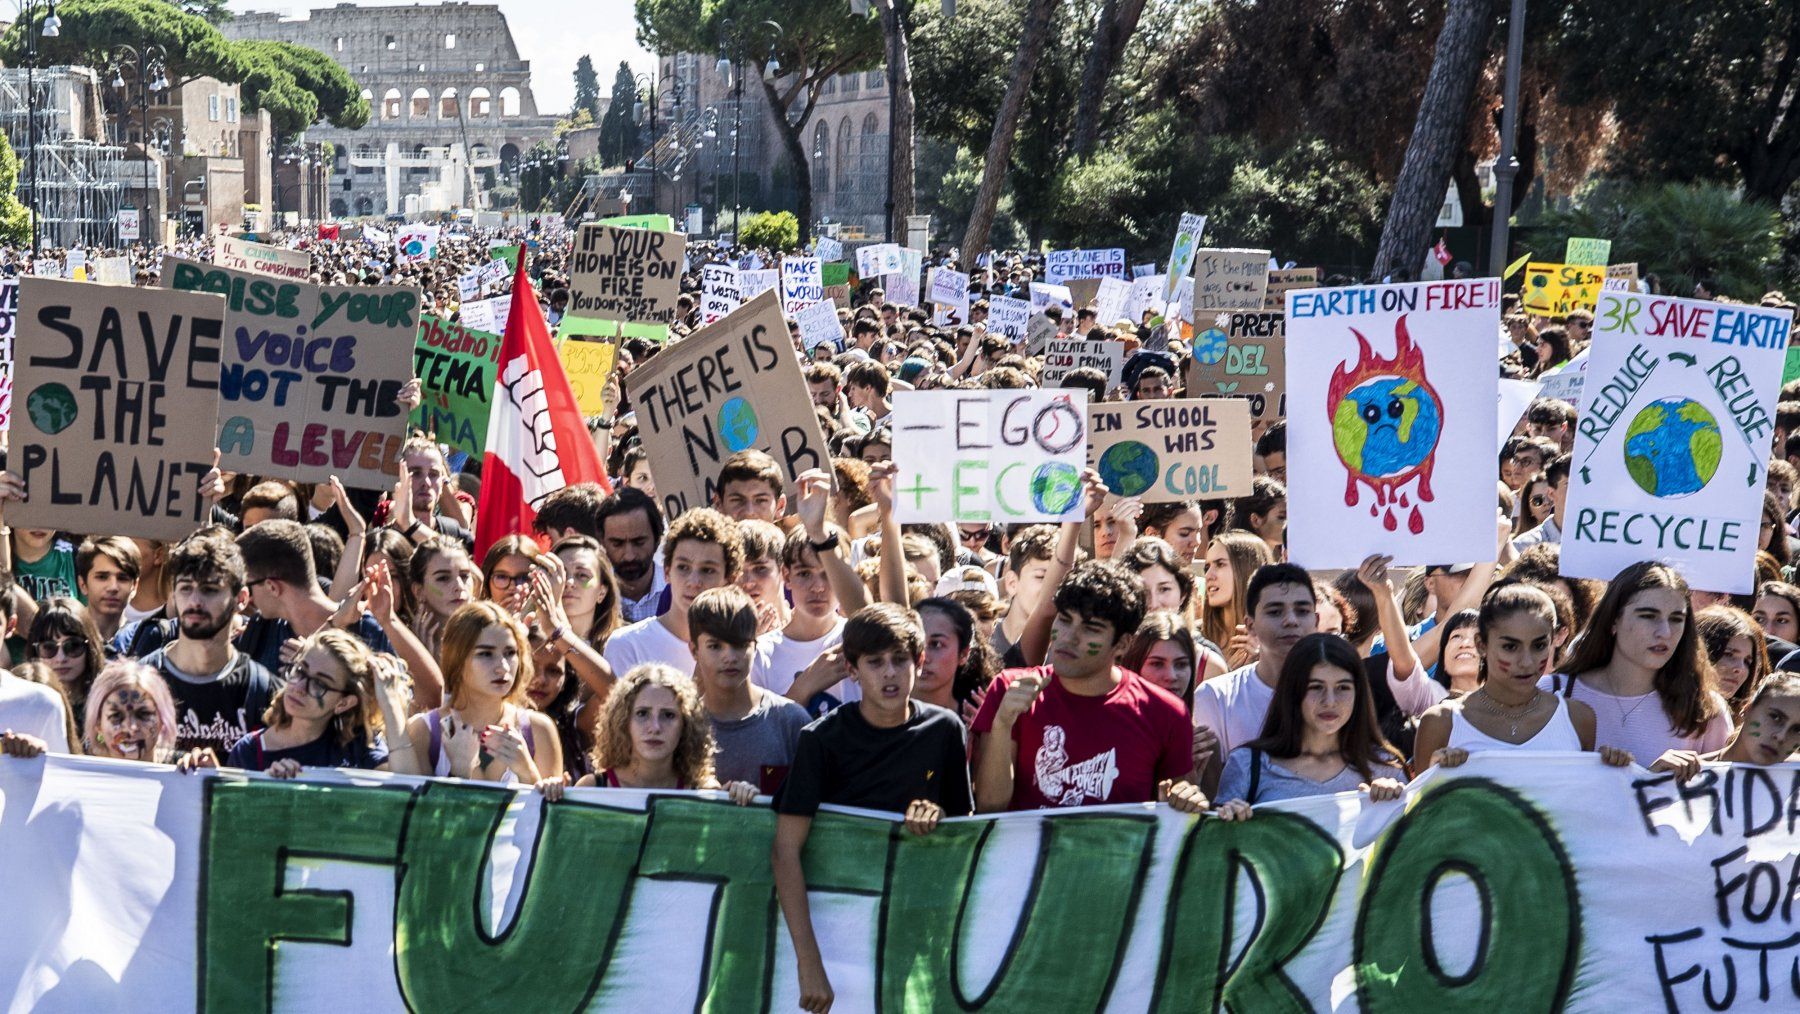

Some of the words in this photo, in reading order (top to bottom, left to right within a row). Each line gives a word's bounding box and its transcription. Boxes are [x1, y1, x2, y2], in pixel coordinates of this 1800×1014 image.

[224, 242, 235, 255] IL
[609, 227, 664, 261] YOUR
[1049, 252, 1069, 263] THIS
[1072, 251, 1106, 263] PLANET
[1110, 250, 1122, 261] IS
[574, 252, 626, 277] HOME
[647, 261, 677, 280] ON
[784, 261, 818, 275] MAKE
[172, 262, 300, 319] RAISE
[623, 297, 658, 312] JUST
[708, 301, 729, 313] ORA
[786, 286, 824, 299] WORLD
[1292, 289, 1376, 319] EARTH
[1380, 287, 1419, 312] ON
[1425, 281, 1500, 312] FIRE!!
[1003, 323, 1019, 340] YOU
[1600, 297, 1642, 335] 3R
[1644, 300, 1715, 338] SAVE
[1711, 308, 1791, 350] EARTH
[30, 305, 223, 390] SAVE
[1046, 354, 1074, 367] CULO
[1079, 355, 1112, 368] PRIMA
[1048, 341, 1087, 353] ALZATE
[1094, 343, 1105, 354] IL
[1225, 344, 1269, 376] DEL
[219, 362, 302, 407] NOT
[414, 347, 486, 403] TEMA
[639, 344, 743, 434] THERE
[742, 323, 779, 374] IS
[1044, 369, 1066, 381] CHE
[80, 375, 166, 446] THE
[1578, 343, 1659, 445] REDUCE
[1706, 354, 1774, 444] REUSE
[219, 415, 255, 456] A
[1092, 412, 1122, 432] IN
[1136, 405, 1217, 430] SCHOOL
[780, 426, 820, 483] B
[1164, 429, 1217, 453] WAS
[22, 443, 214, 522] PLANET
[1164, 461, 1228, 495] COOL
[1575, 507, 1742, 552] RECYCLE
[1071, 772, 1104, 797] POWER
[197, 775, 1582, 1014] FUTURO
